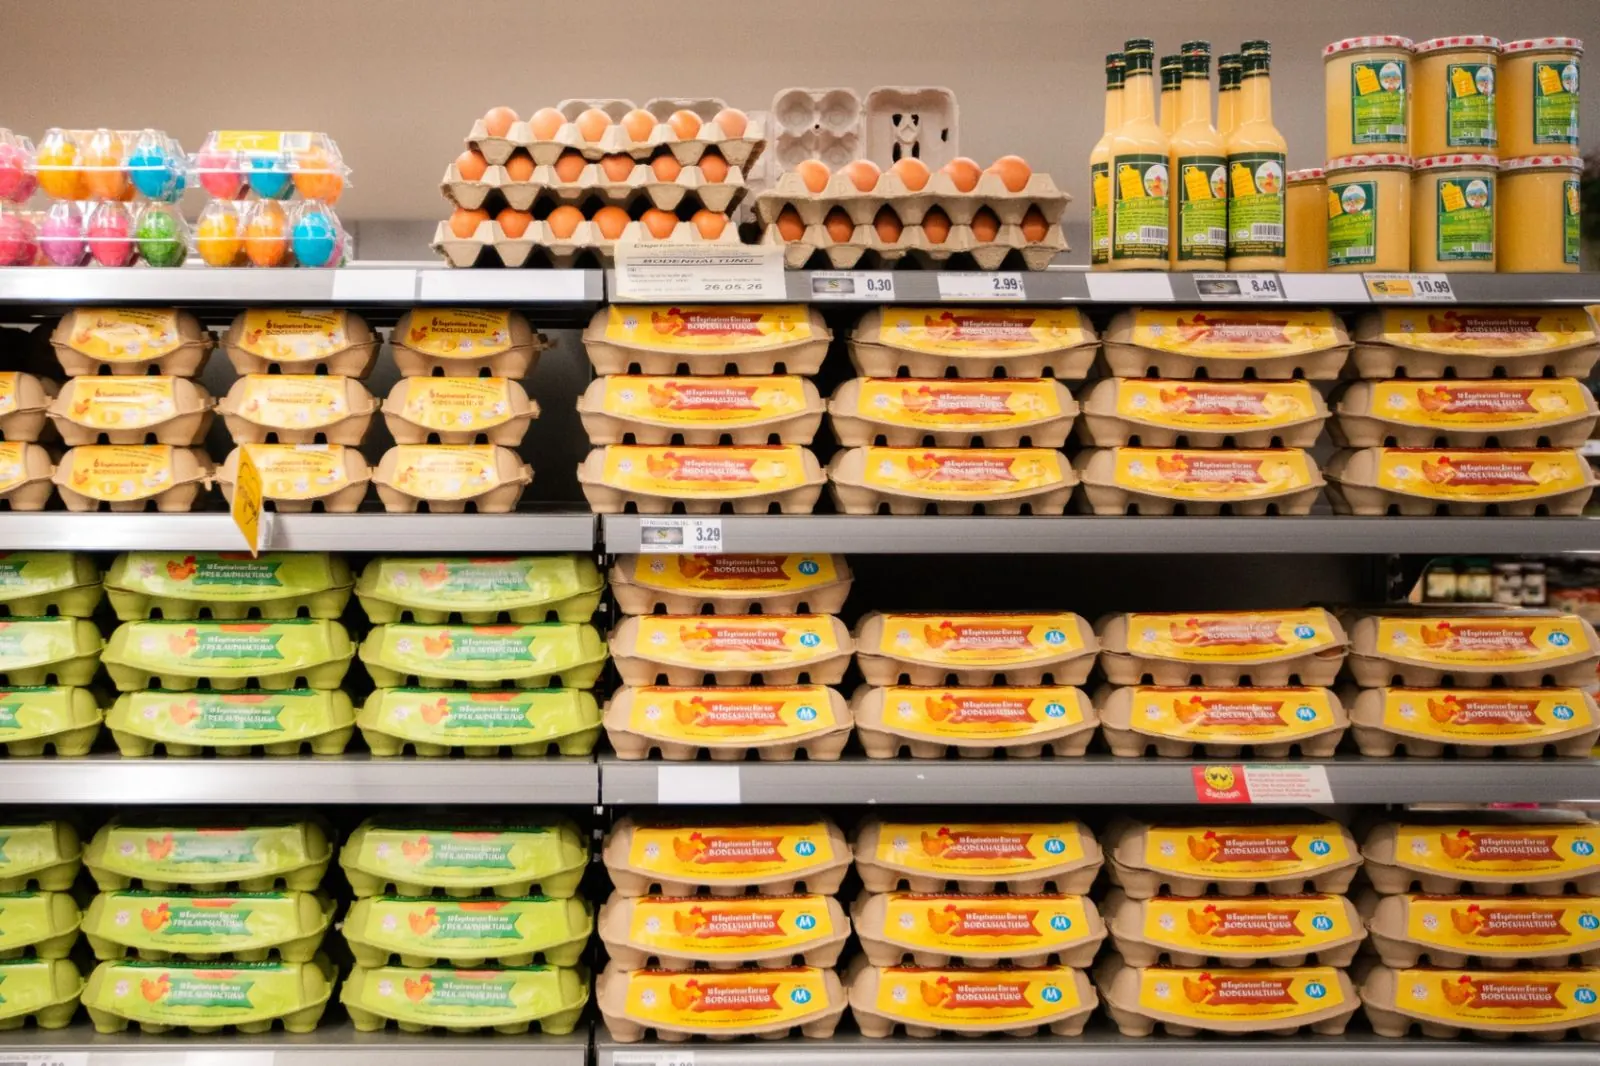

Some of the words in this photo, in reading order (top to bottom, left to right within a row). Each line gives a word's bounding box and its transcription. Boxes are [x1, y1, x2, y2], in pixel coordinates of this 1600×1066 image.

[867, 278, 892, 291] 0.30
[993, 278, 1018, 290] 2.99
[1252, 280, 1277, 292] 8.49
[1417, 280, 1450, 294] 10.99
[696, 527, 720, 541] 3.29
[803, 563, 814, 572] M
[1049, 632, 1061, 643] M
[1299, 627, 1310, 638] M
[804, 634, 815, 645] M
[1552, 634, 1563, 644] M
[801, 708, 812, 719] M
[1049, 705, 1061, 716] M
[1300, 708, 1312, 718] M
[1557, 707, 1569, 718] M
[708, 847, 774, 855] BODENHALTUNG
[799, 843, 811, 853] M
[1048, 842, 1060, 851] M
[1314, 842, 1326, 852] M
[1576, 843, 1589, 854] M
[708, 921, 775, 930] BODENHALTUNG
[799, 917, 811, 927] M
[1054, 919, 1066, 928] M
[1316, 917, 1328, 929] M
[1583, 916, 1595, 928] M
[795, 990, 806, 1001] M
[1046, 989, 1057, 999] M
[1310, 985, 1321, 995] M
[1579, 990, 1592, 1001] M
[705, 994, 770, 1003] BODENHALTUNG
